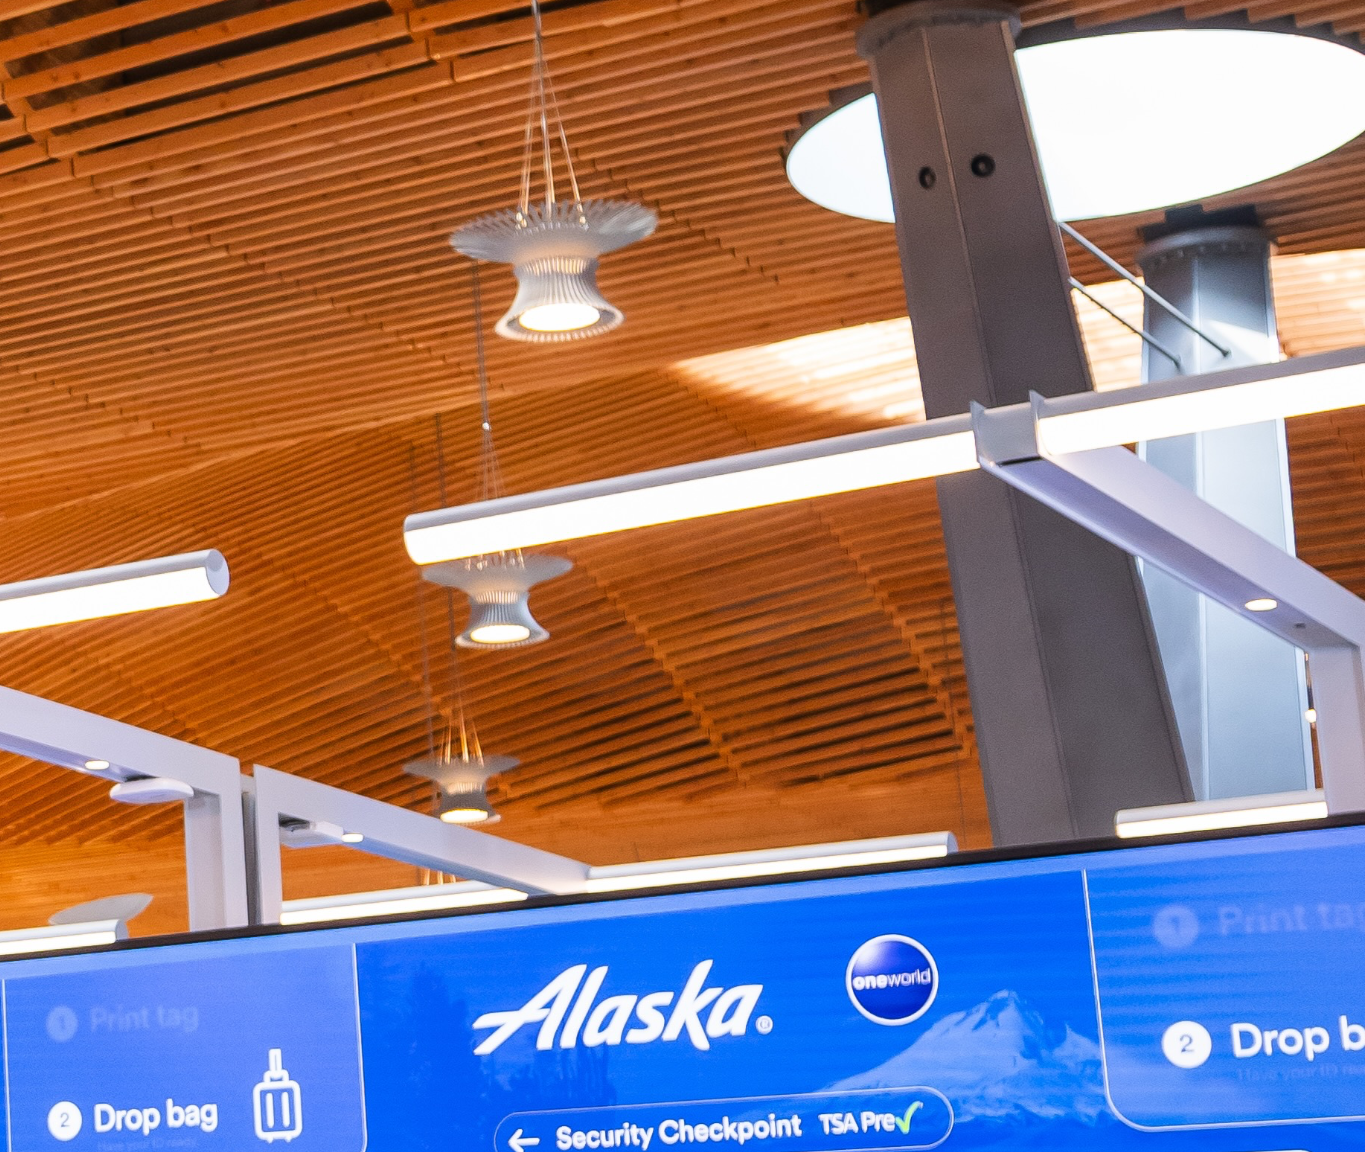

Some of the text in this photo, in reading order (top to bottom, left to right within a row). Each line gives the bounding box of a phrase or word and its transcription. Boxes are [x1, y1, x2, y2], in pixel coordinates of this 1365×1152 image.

[852, 967, 931, 991] oneworld
[473, 959, 764, 1055] Alaska
[1179, 1034, 1193, 1054] 2
[1231, 1022, 1329, 1061] Drop
[59, 1098, 218, 1136] 2 Drop bag
[556, 1122, 653, 1151] Security
[659, 1113, 802, 1145] Checkpoint
[819, 1111, 858, 1134] TSA
